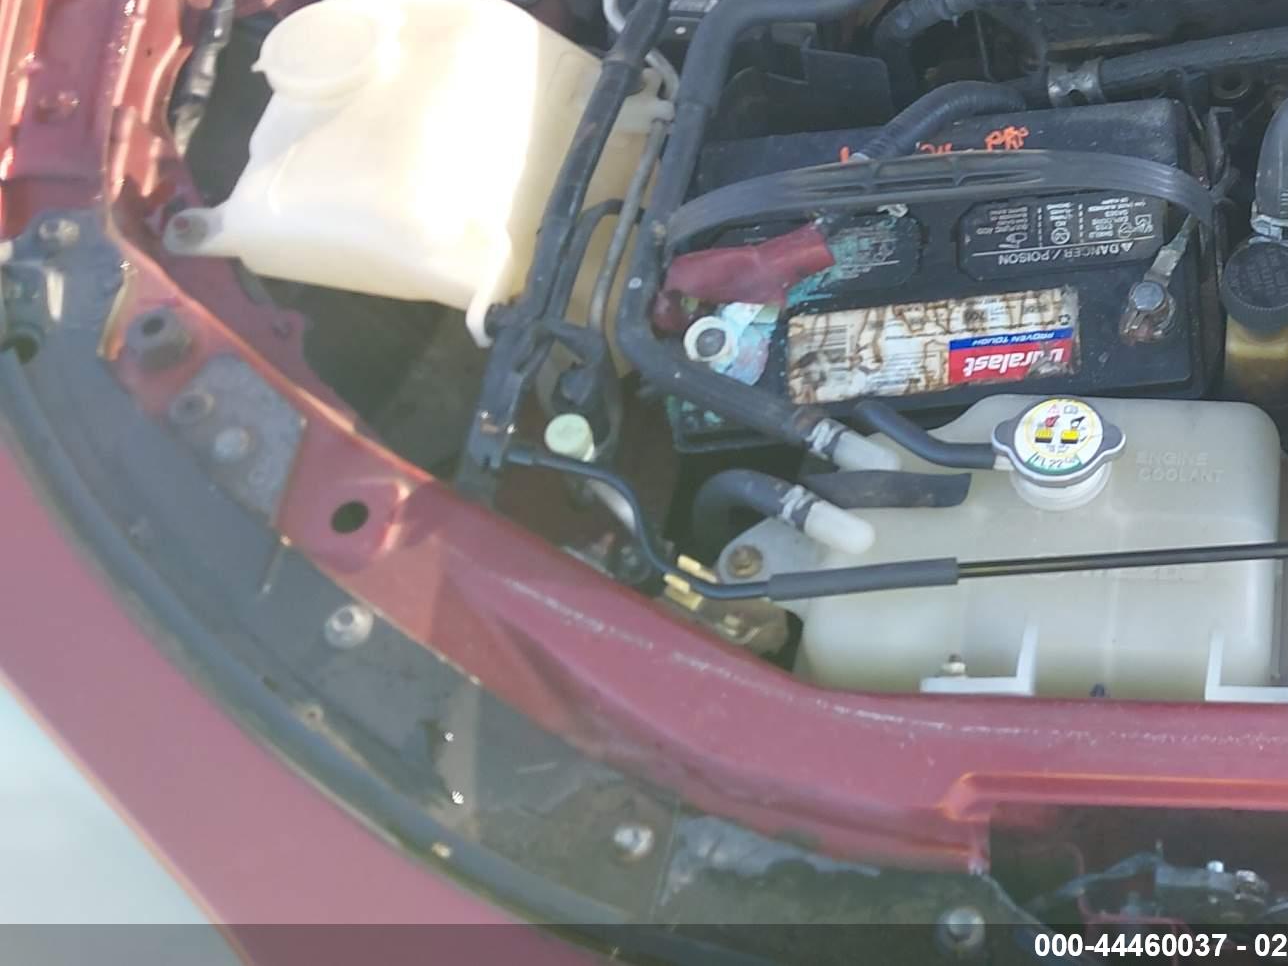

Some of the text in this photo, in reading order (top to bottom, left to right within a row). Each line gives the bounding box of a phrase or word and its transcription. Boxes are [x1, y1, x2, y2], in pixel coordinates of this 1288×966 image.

[998, 249, 1050, 266] POISON
[1064, 242, 1120, 259] DANGER
[972, 332, 1055, 347] PROVEN TOUGH
[1136, 450, 1209, 467] ENGINE
[1139, 466, 1225, 483] COOLANT
